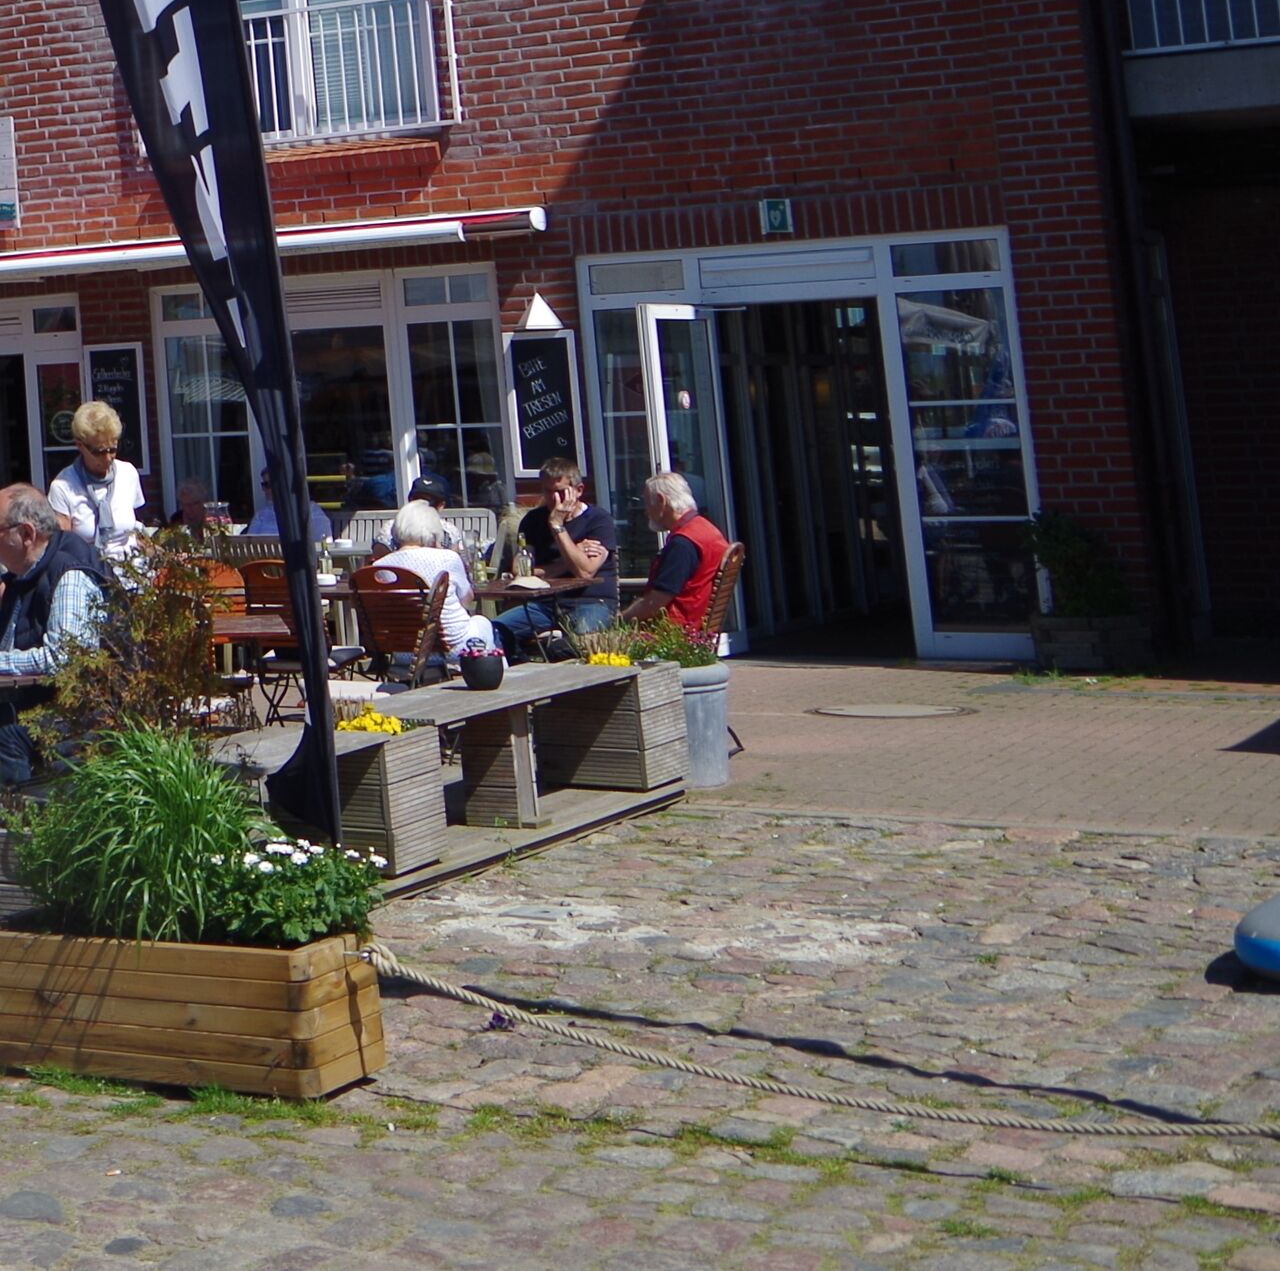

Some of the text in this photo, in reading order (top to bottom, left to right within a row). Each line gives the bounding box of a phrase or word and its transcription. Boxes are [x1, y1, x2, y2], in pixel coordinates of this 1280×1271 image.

[530, 378, 546, 395] AM
[523, 391, 563, 417] TRESEN
[522, 409, 569, 439] BESTELLEN
